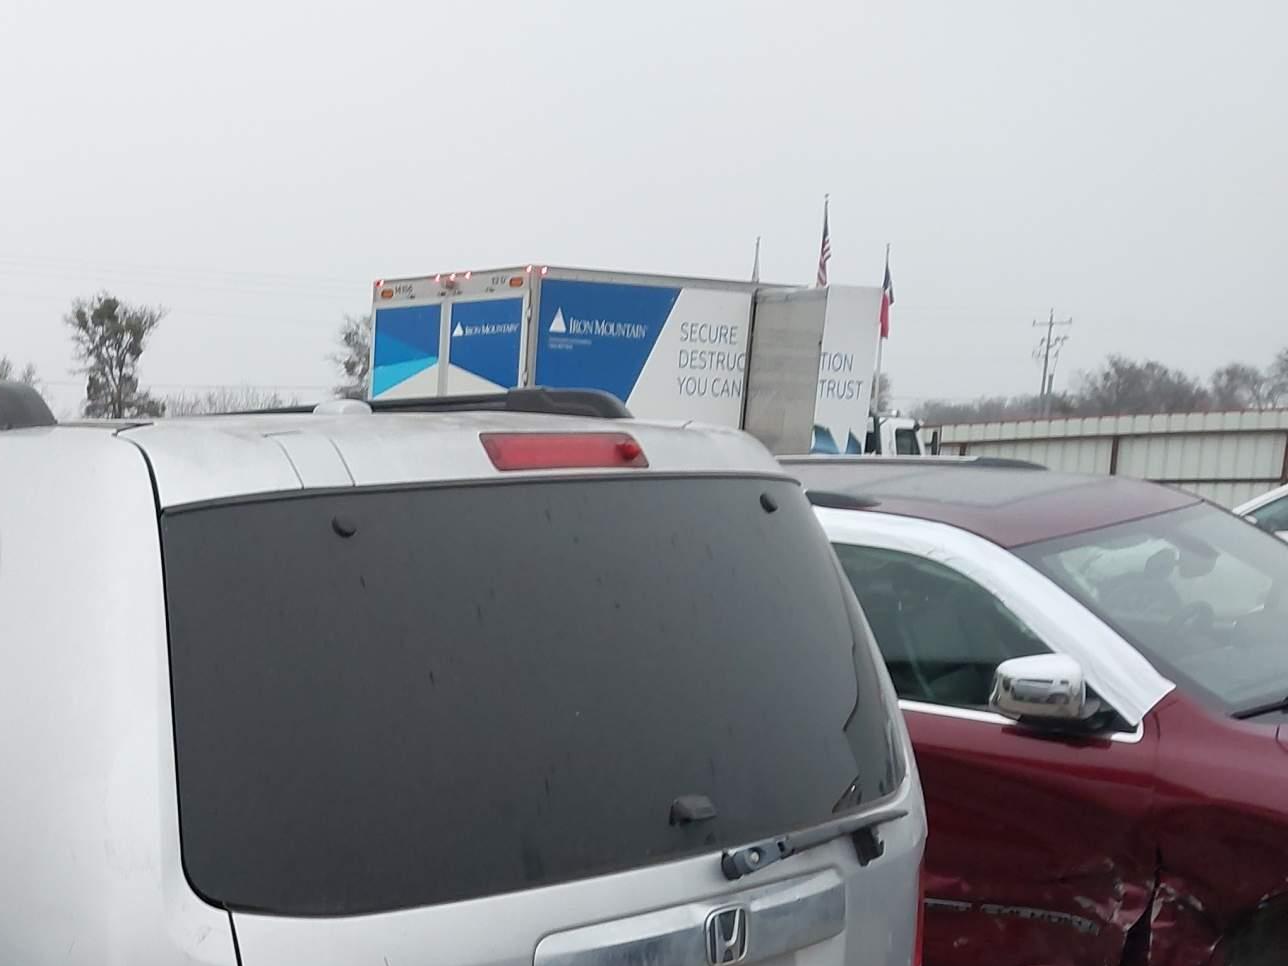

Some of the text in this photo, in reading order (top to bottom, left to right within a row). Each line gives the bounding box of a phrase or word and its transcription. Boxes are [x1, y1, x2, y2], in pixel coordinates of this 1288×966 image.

[569, 316, 647, 339] IRON MOUNTAIN
[679, 321, 738, 345] SECURE
[677, 376, 863, 401] YOU CAN TRUST
